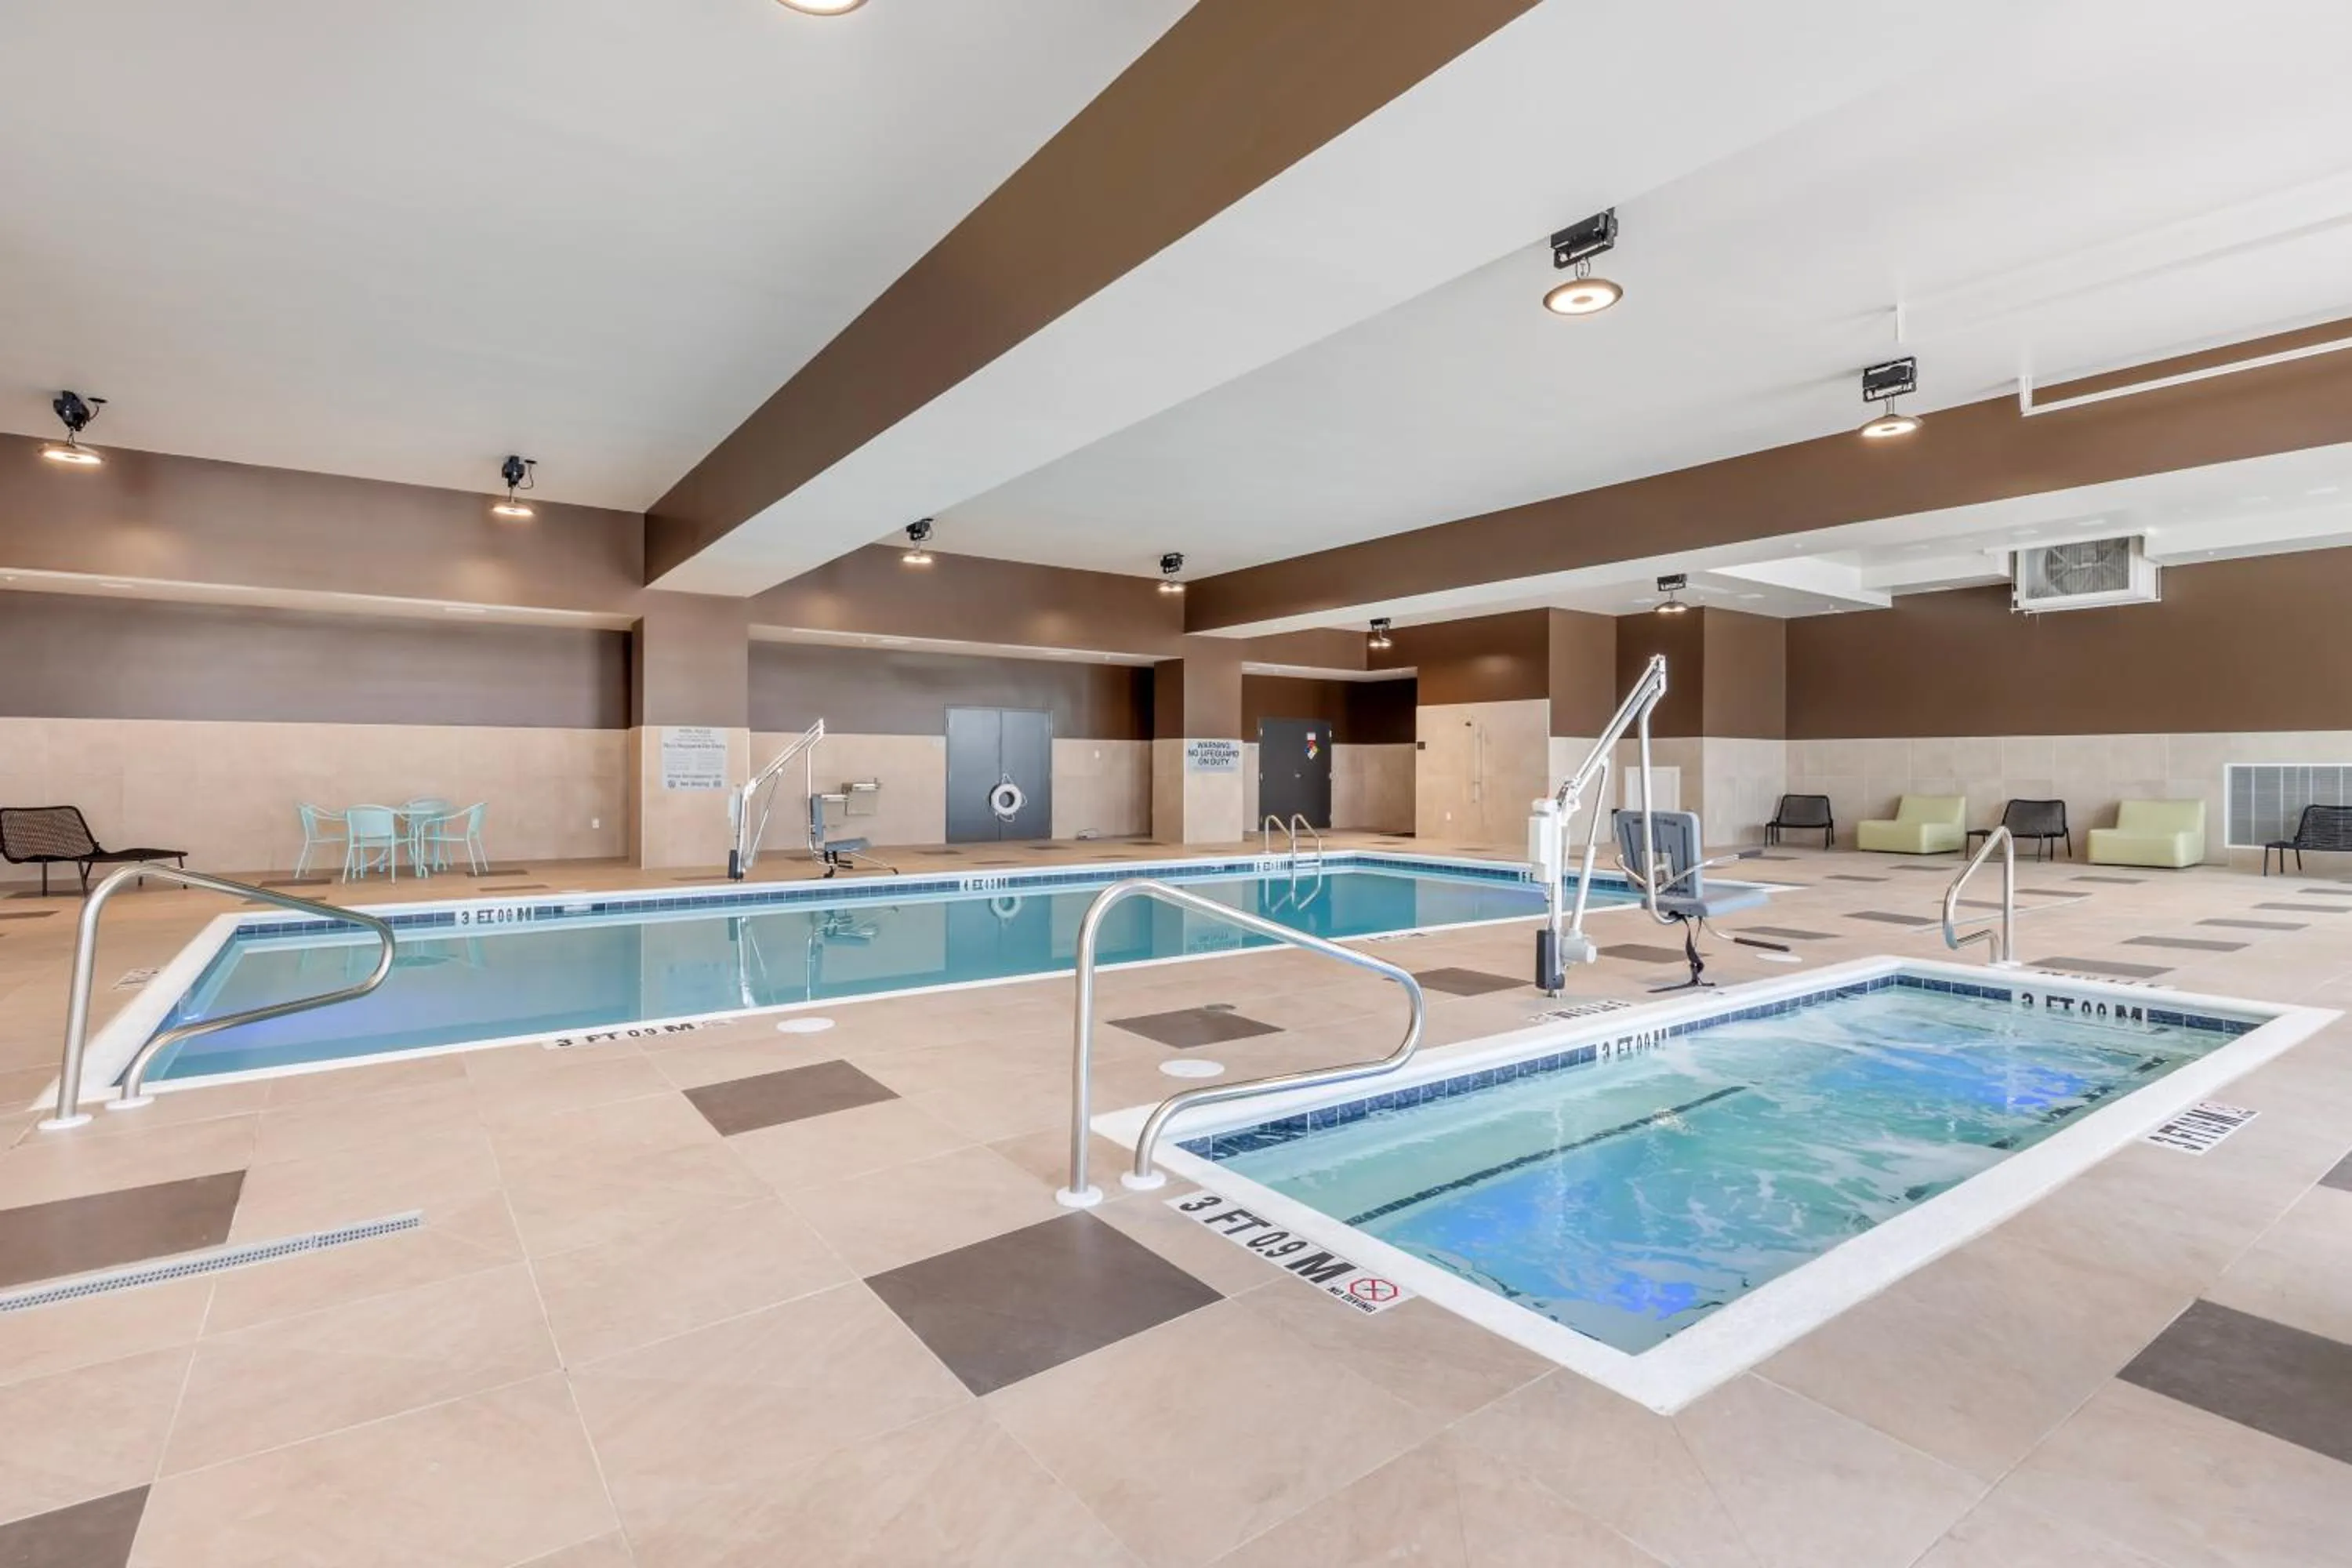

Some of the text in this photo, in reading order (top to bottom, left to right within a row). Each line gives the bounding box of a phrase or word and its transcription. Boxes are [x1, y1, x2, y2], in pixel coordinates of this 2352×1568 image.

[1197, 757, 1209, 766] ON
[1179, 1196, 1358, 1284] 3 FT 0.9 M
